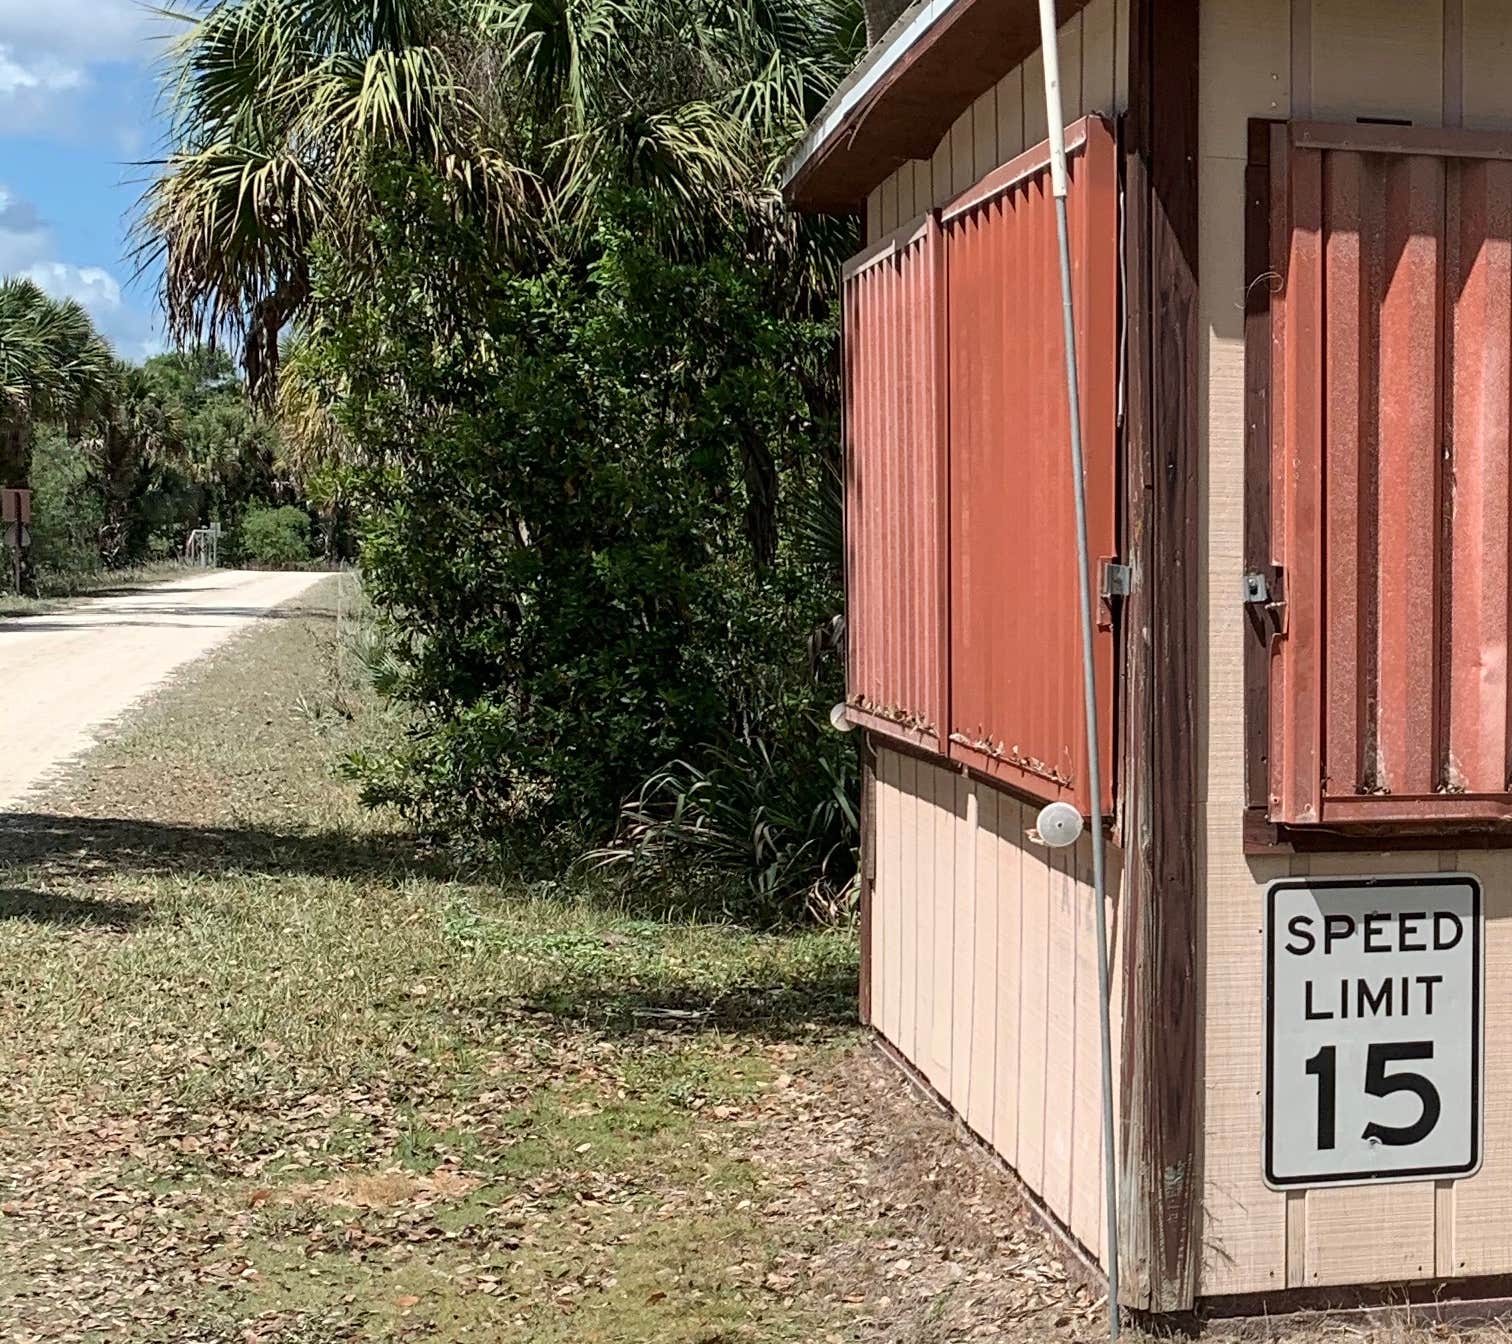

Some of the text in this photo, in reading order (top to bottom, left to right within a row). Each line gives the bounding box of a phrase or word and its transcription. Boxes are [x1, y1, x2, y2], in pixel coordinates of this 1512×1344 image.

[1284, 911, 1464, 956] SPEED
[1304, 975, 1443, 1020] LIMIT
[1305, 1040, 1441, 1150] 15
